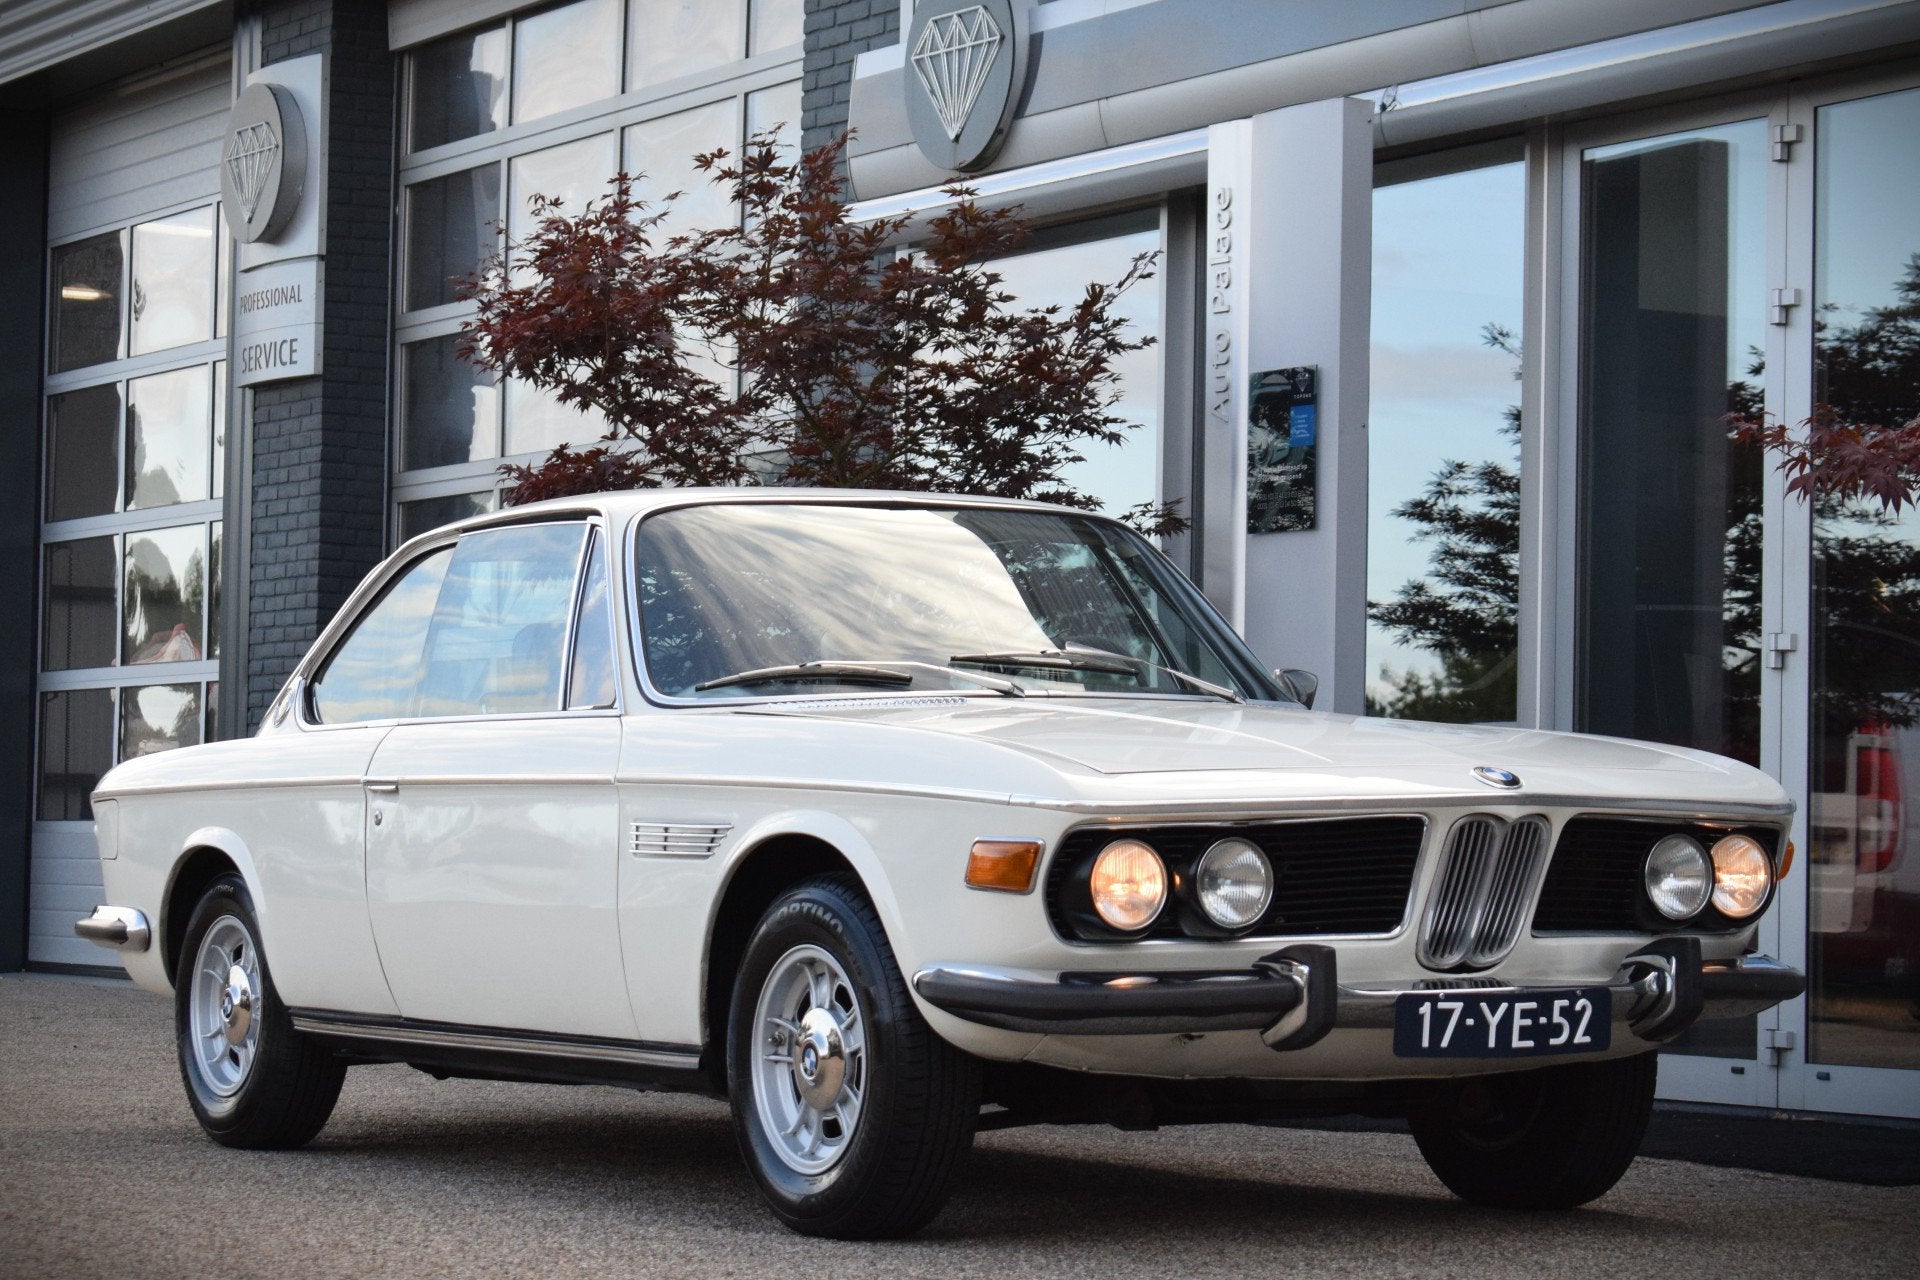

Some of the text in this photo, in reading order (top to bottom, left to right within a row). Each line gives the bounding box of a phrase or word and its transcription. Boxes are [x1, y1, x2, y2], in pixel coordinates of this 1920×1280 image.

[240, 284, 302, 316] PROFESSIONAL
[1210, 187, 1232, 424] Auto Palace
[242, 338, 298, 373] SERVICE
[1418, 998, 1593, 1048] 17-YE-52
